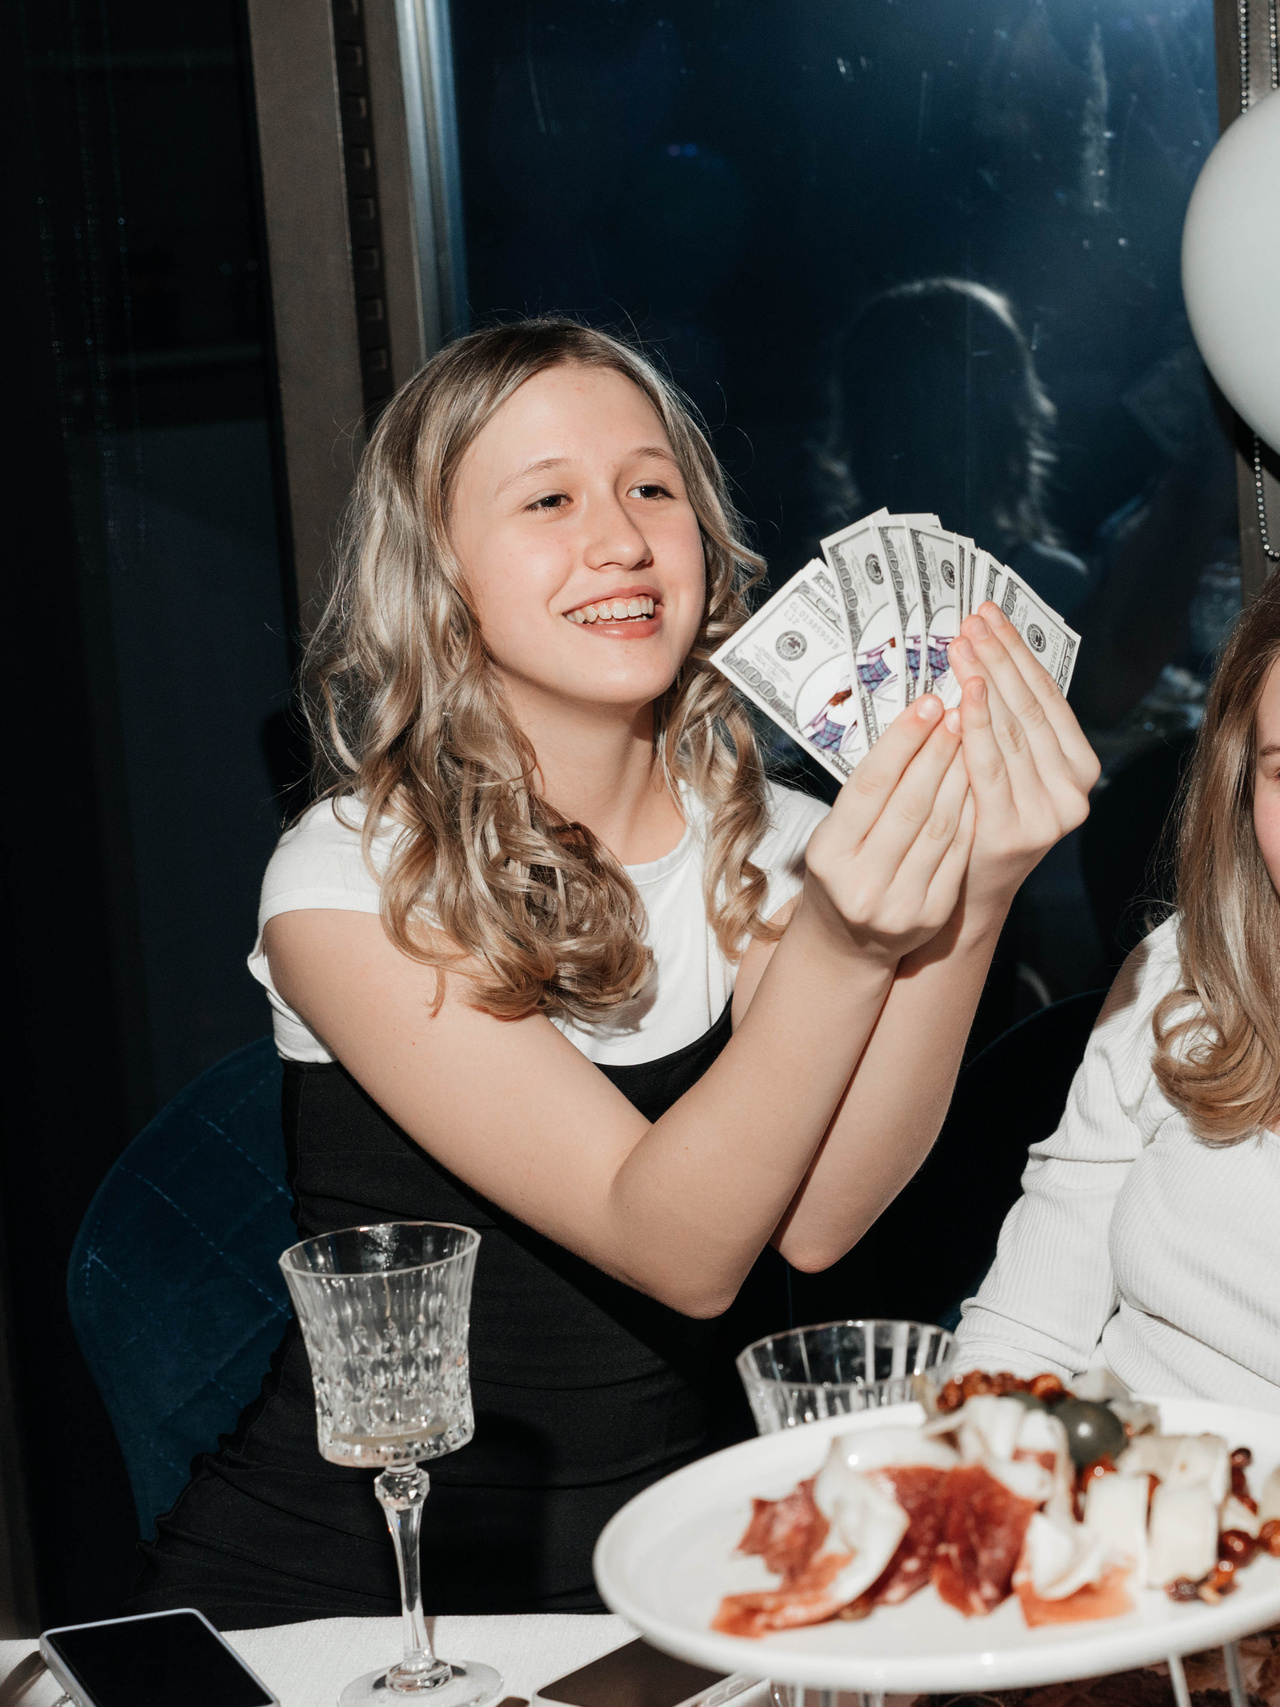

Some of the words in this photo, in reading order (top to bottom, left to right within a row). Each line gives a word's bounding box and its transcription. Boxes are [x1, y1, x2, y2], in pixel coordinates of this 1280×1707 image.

[834, 556, 859, 610] 100
[884, 539, 905, 592] 100
[914, 541, 931, 592] 100
[734, 658, 778, 702] 100
